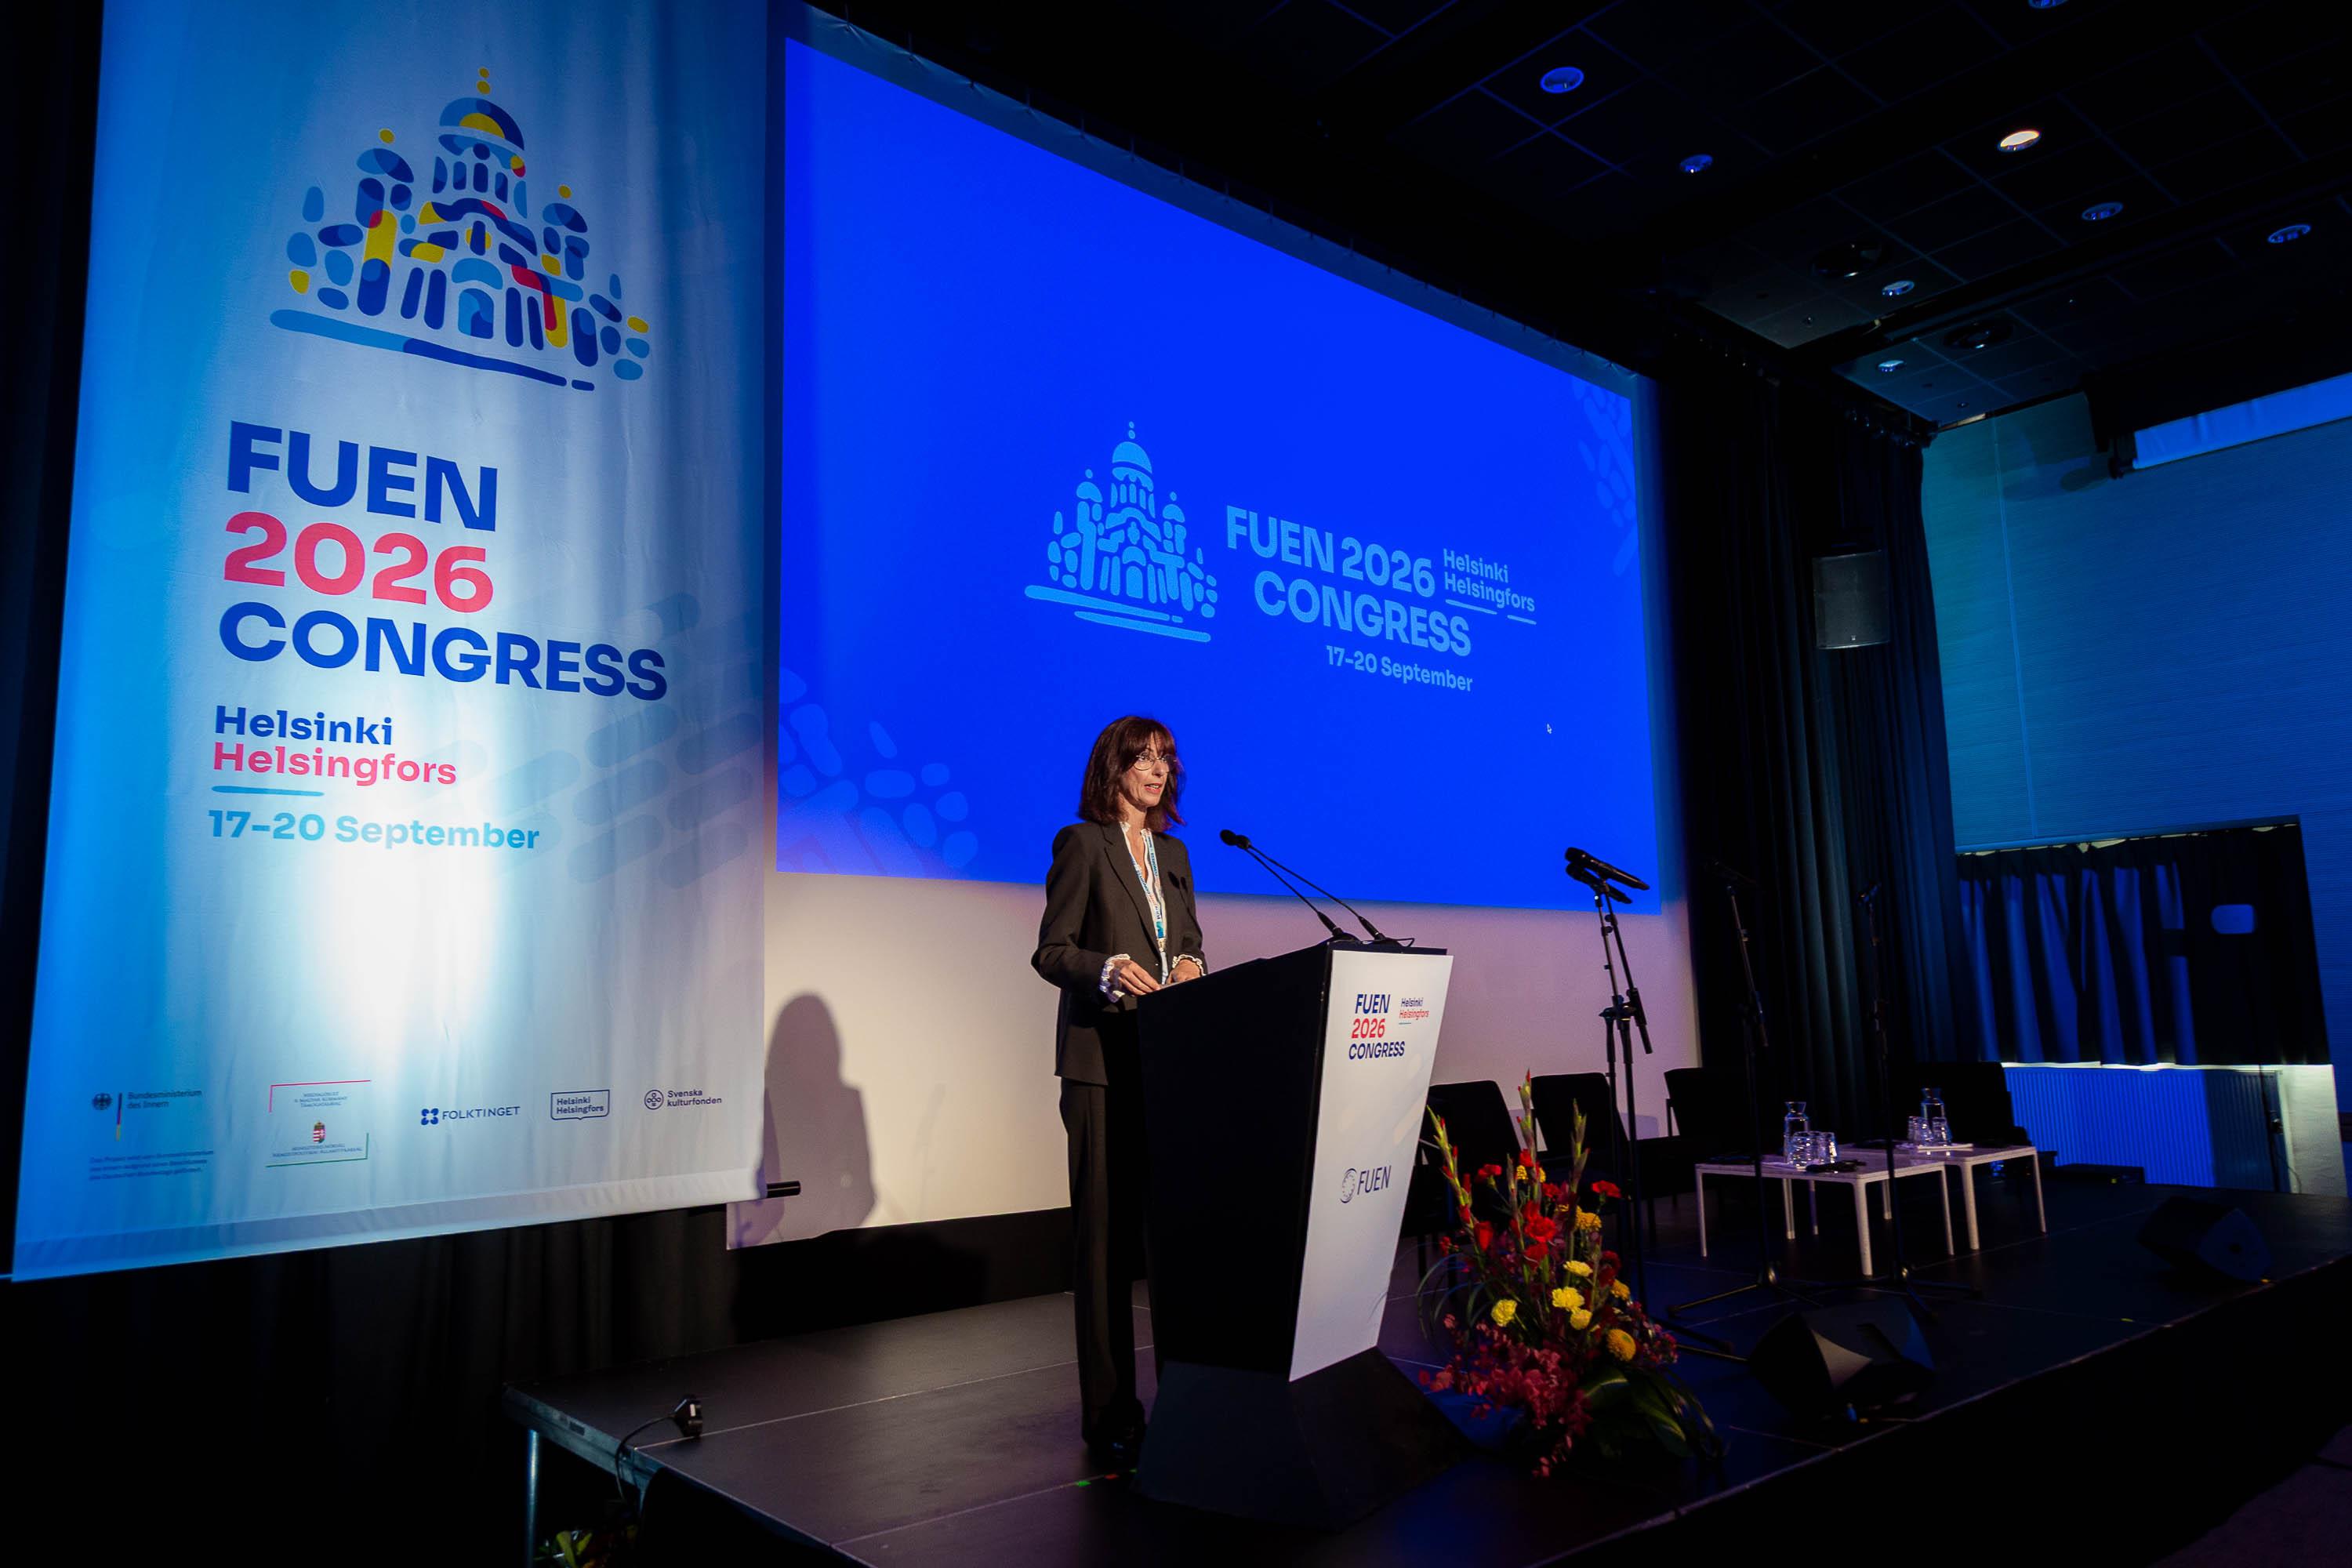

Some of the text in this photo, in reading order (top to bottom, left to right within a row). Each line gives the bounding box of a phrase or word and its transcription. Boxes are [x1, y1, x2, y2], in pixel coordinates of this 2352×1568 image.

[227, 420, 498, 532] FUEN
[224, 511, 493, 612] 2026
[1227, 505, 1436, 597] FUEN 2026
[1443, 548, 1508, 583] Helsinki
[1445, 573, 1535, 612] Helsingfors
[1255, 571, 1472, 656] CONGRESS
[220, 601, 668, 700] CONGRESS
[1381, 657, 1473, 691] September
[215, 706, 392, 745] Helsinki
[213, 742, 457, 786] Helsingfors
[336, 815, 539, 850] September
[1355, 993, 1390, 1014] FUEN
[1399, 1009, 1429, 1020] Helsingfors
[1401, 997, 1424, 1007] Helsinki
[1351, 1018, 1385, 1039] 2026
[1348, 1041, 1406, 1060] CONGRESS
[557, 1096, 591, 1105] Helsinki
[667, 1097, 722, 1107] kulturfonden
[668, 1089, 703, 1098] Svenska
[442, 1106, 521, 1120] FOLKTINGET
[557, 1105, 604, 1115] Helsingfors
[1357, 1165, 1392, 1196] FUEN
